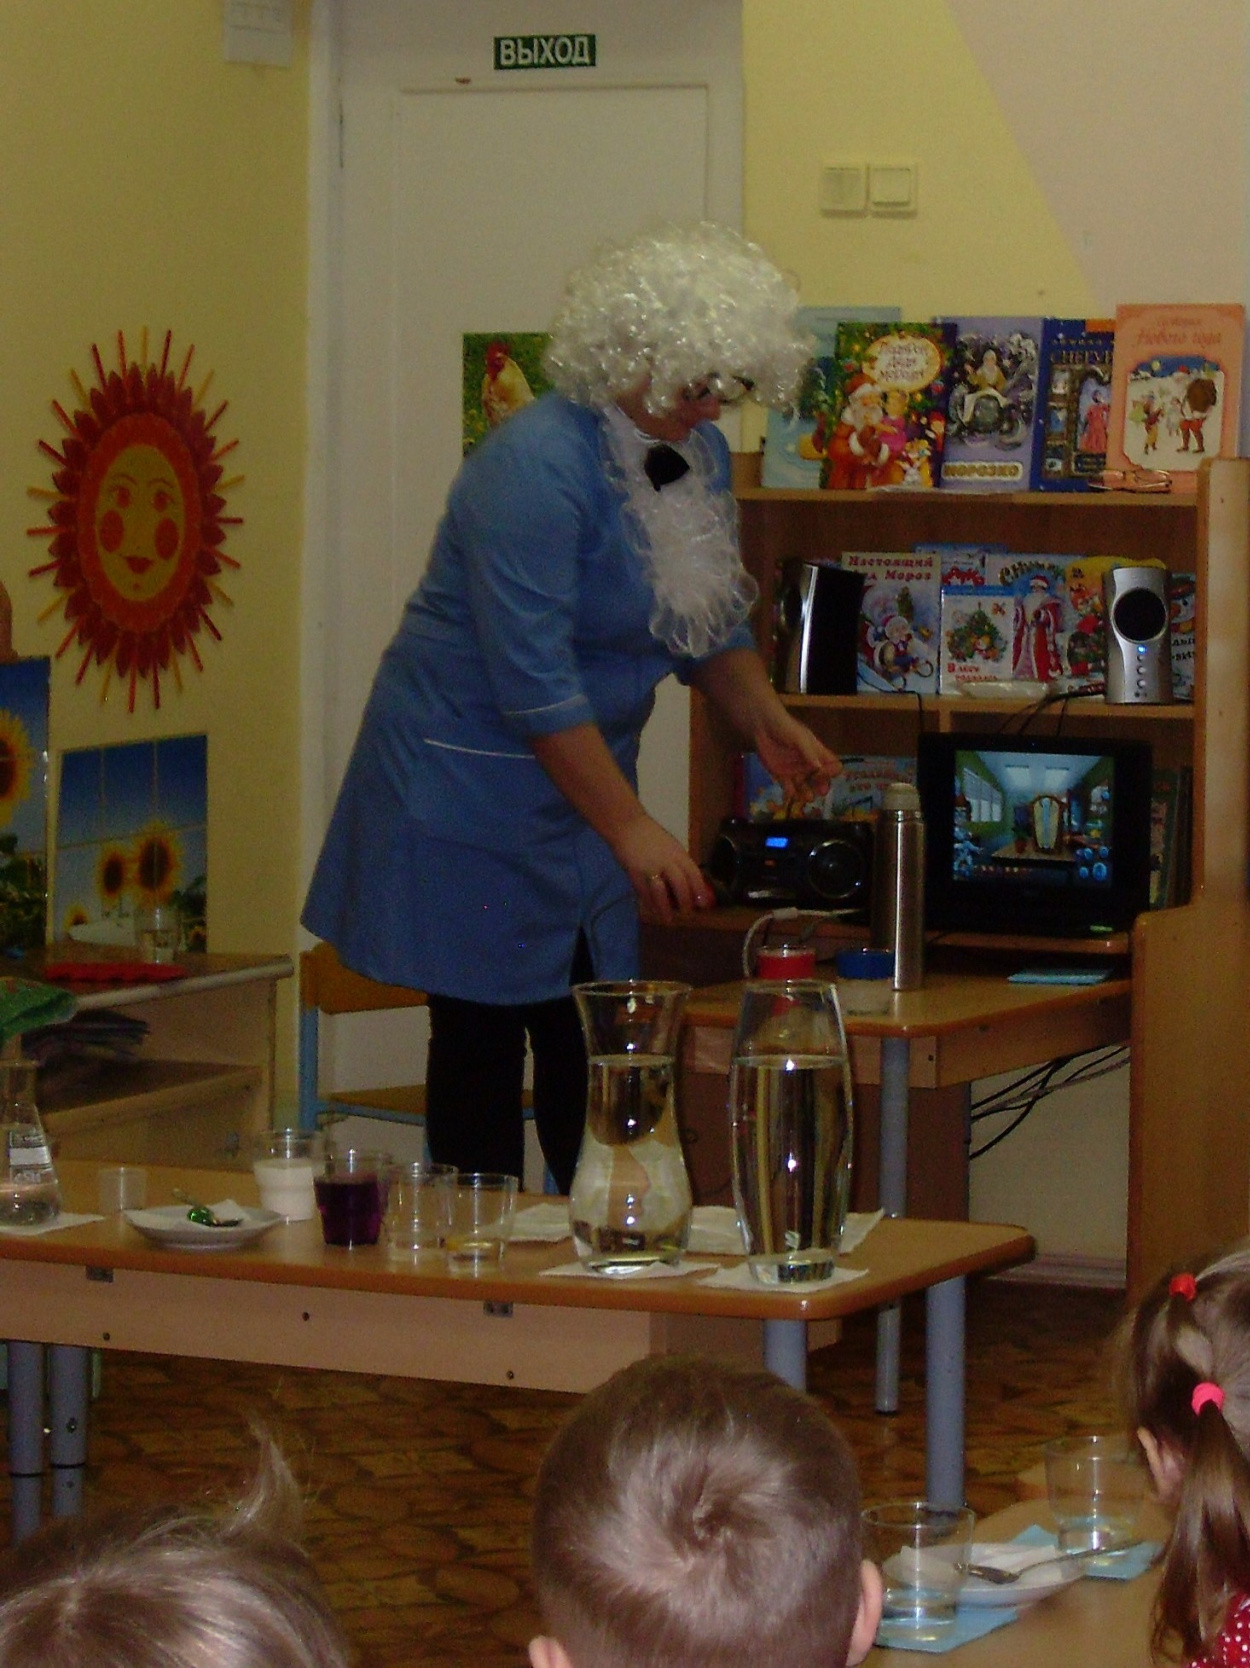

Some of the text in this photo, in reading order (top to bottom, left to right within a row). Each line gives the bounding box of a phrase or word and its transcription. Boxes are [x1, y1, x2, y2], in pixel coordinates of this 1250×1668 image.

[500, 36, 591, 66] ВЫХОД
[943, 464, 1019, 478] МОРОЗКО
[849, 556, 934, 569] Настоящий
[884, 570, 932, 582] Мороз
